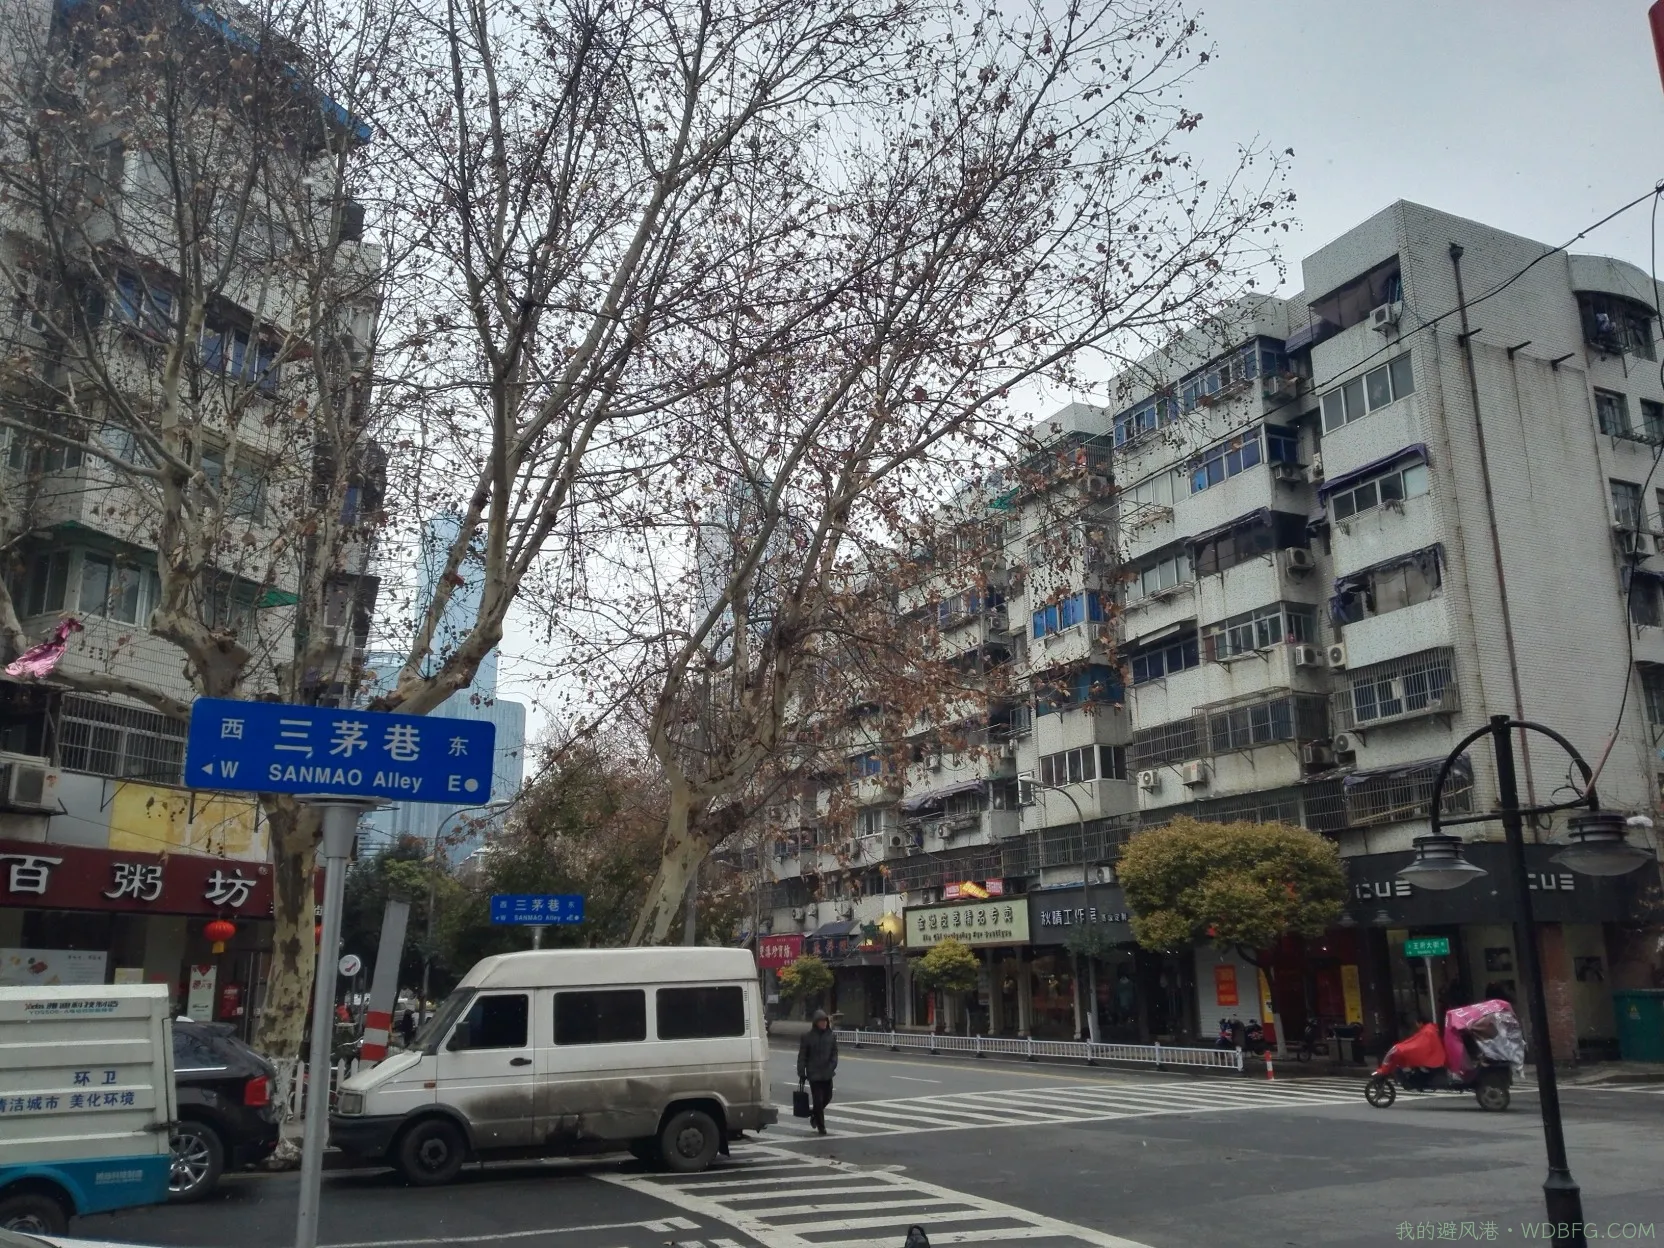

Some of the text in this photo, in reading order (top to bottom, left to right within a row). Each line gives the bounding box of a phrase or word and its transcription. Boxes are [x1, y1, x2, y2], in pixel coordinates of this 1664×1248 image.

[221, 718, 469, 762] 西 三茅巷 东
[220, 760, 462, 794] W SANMAO Alley E
[0, 853, 257, 908] 百粥坊
[514, 898, 560, 912] 三茅巷
[514, 913, 543, 922] SANMAO
[545, 913, 561, 924] Alley
[73, 1070, 117, 1087] 环卫
[69, 1091, 135, 1109] 美化环境
